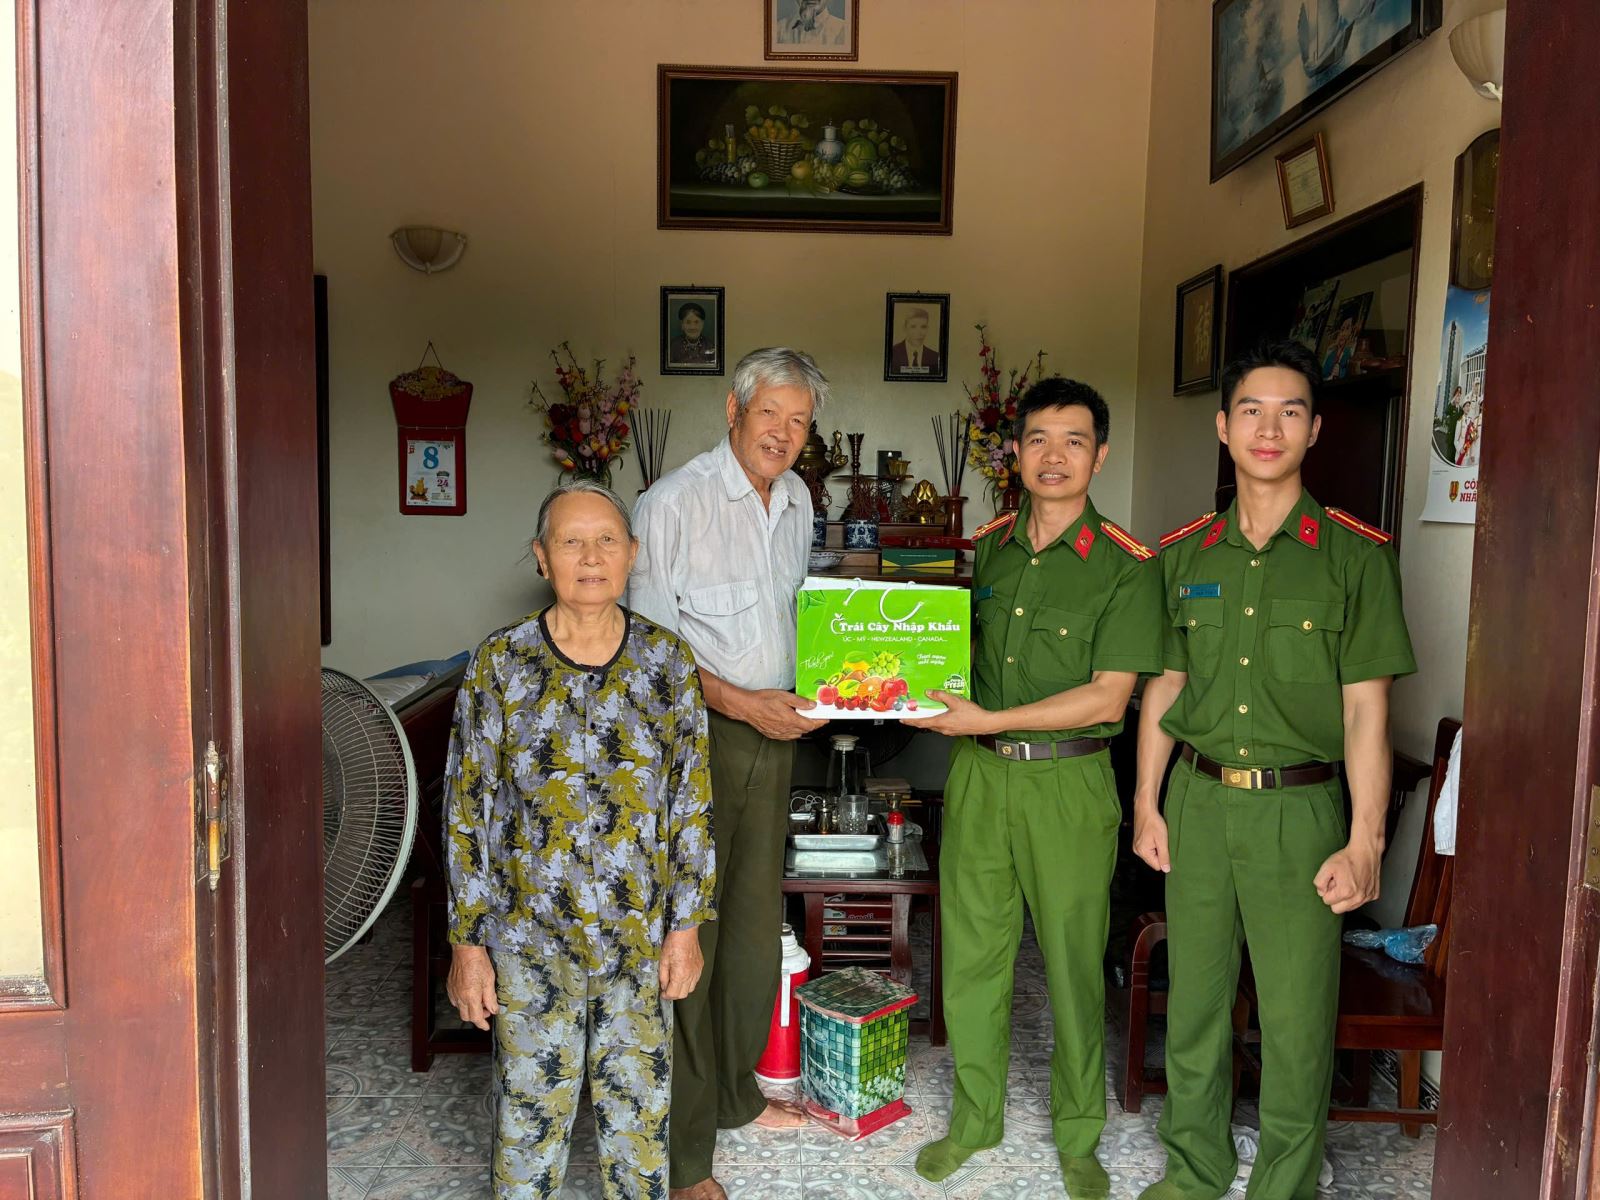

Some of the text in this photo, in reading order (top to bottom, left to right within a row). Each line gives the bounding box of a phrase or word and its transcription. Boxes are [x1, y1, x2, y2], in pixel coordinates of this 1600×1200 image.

[423, 446, 439, 469] 8
[437, 479, 449, 488] 24
[840, 619, 960, 634] Trái Cây Nhập Khẩu
